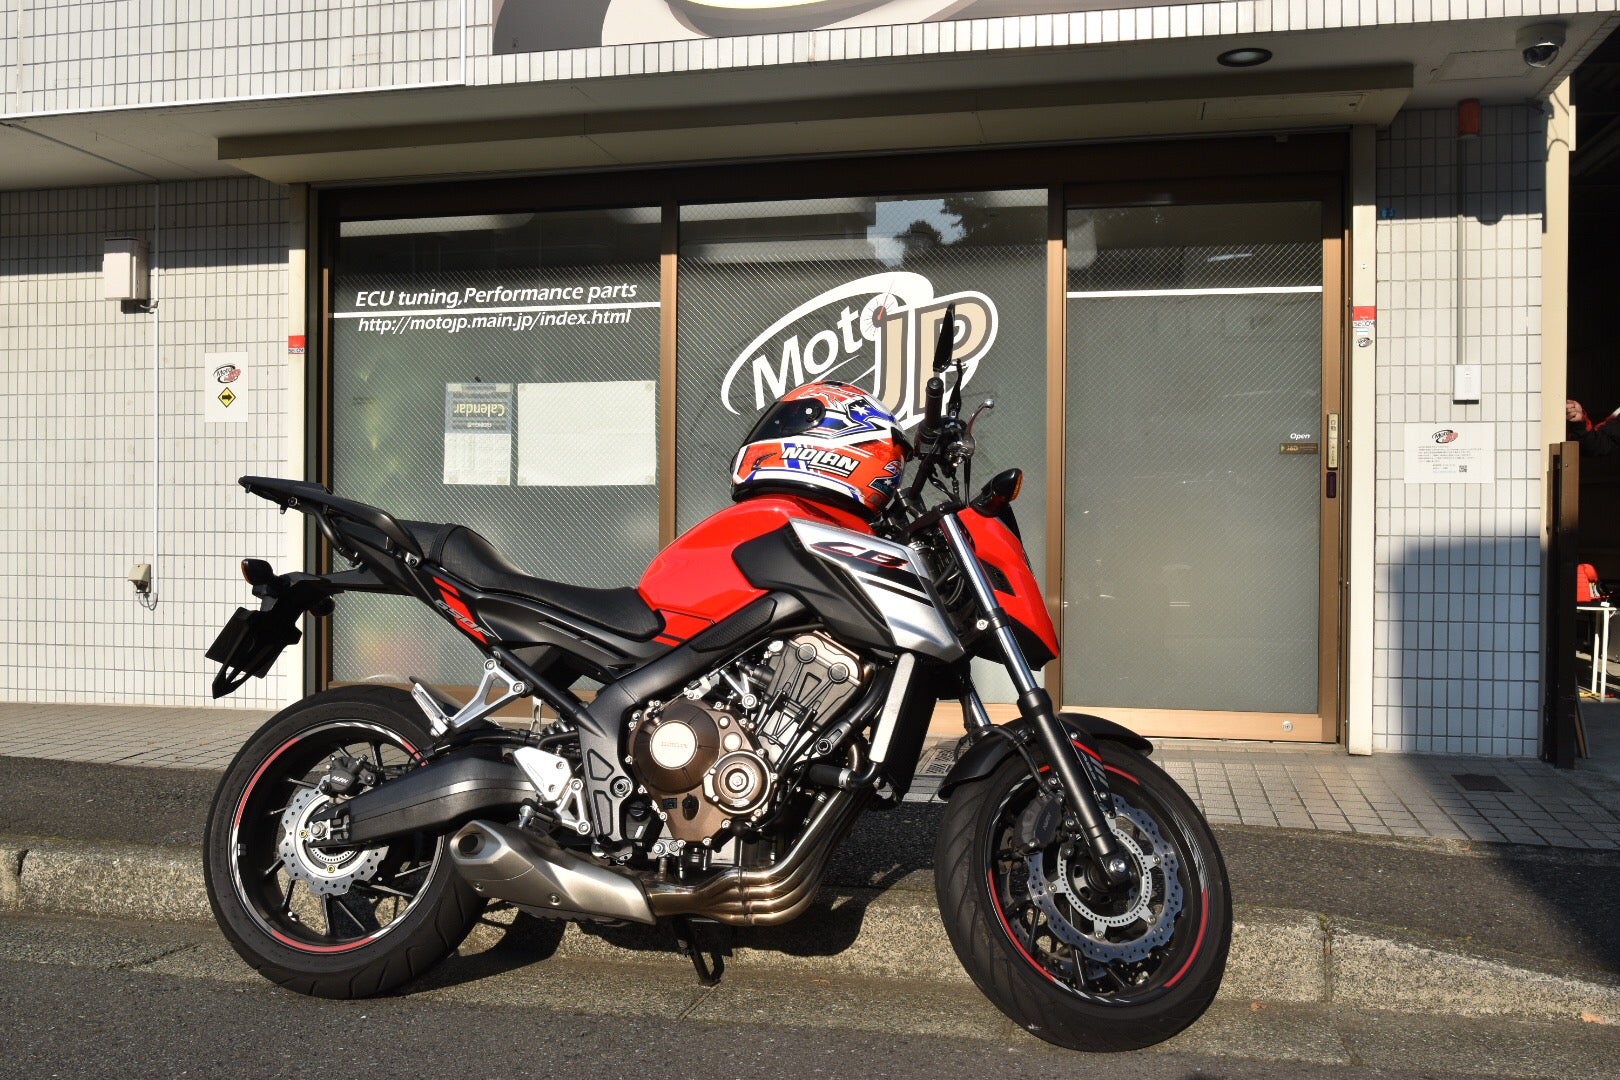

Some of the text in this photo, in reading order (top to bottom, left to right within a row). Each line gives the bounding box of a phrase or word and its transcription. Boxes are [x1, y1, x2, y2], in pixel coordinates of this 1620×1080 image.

[355, 290, 394, 307] ECU
[587, 282, 637, 304] parts
[358, 308, 632, 335] http://motojp.main.jp/index.html
[750, 292, 899, 411] Moto
[453, 402, 505, 418] Calendar
[1290, 432, 1311, 441] Open
[780, 446, 860, 472] NOLAN
[810, 541, 909, 568] CB
